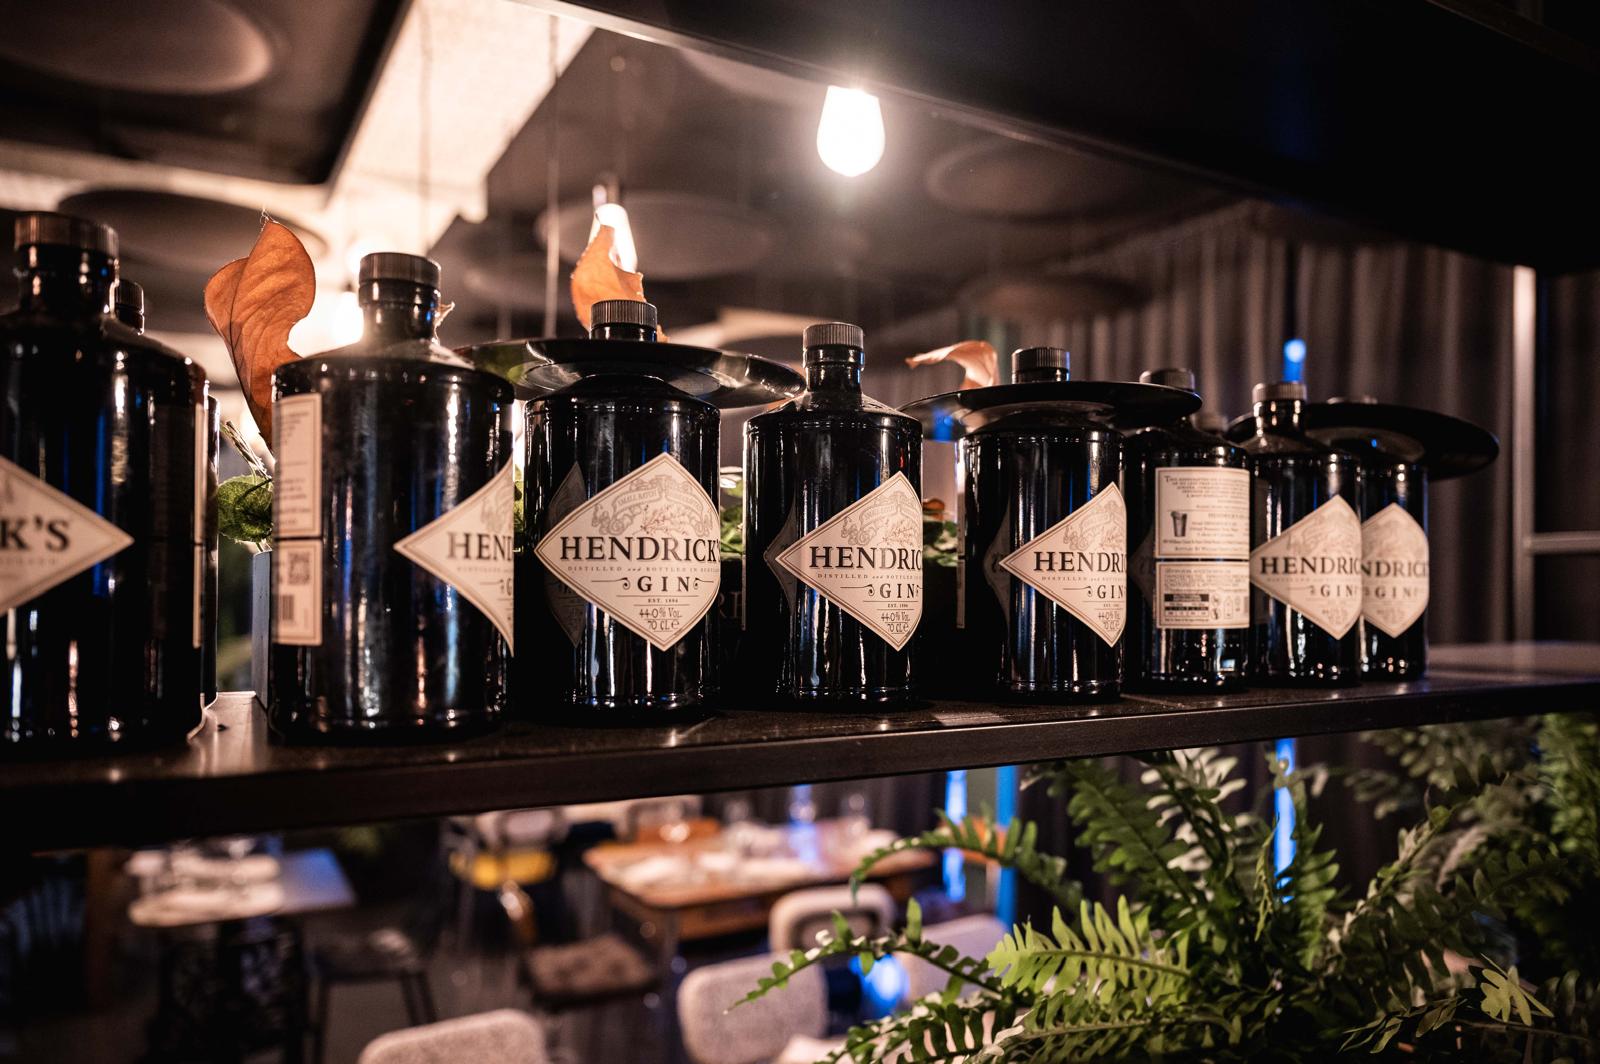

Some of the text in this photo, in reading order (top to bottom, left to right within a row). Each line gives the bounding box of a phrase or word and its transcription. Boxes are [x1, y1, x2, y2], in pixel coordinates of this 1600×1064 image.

[0, 516, 71, 552] K'S
[560, 536, 720, 563] HENDRICK'
[637, 576, 690, 592] GIN
[880, 583, 915, 599] GIN
[1097, 584, 1124, 599] GIN
[1320, 585, 1353, 597] GIN
[1375, 587, 1412, 599] GIN
